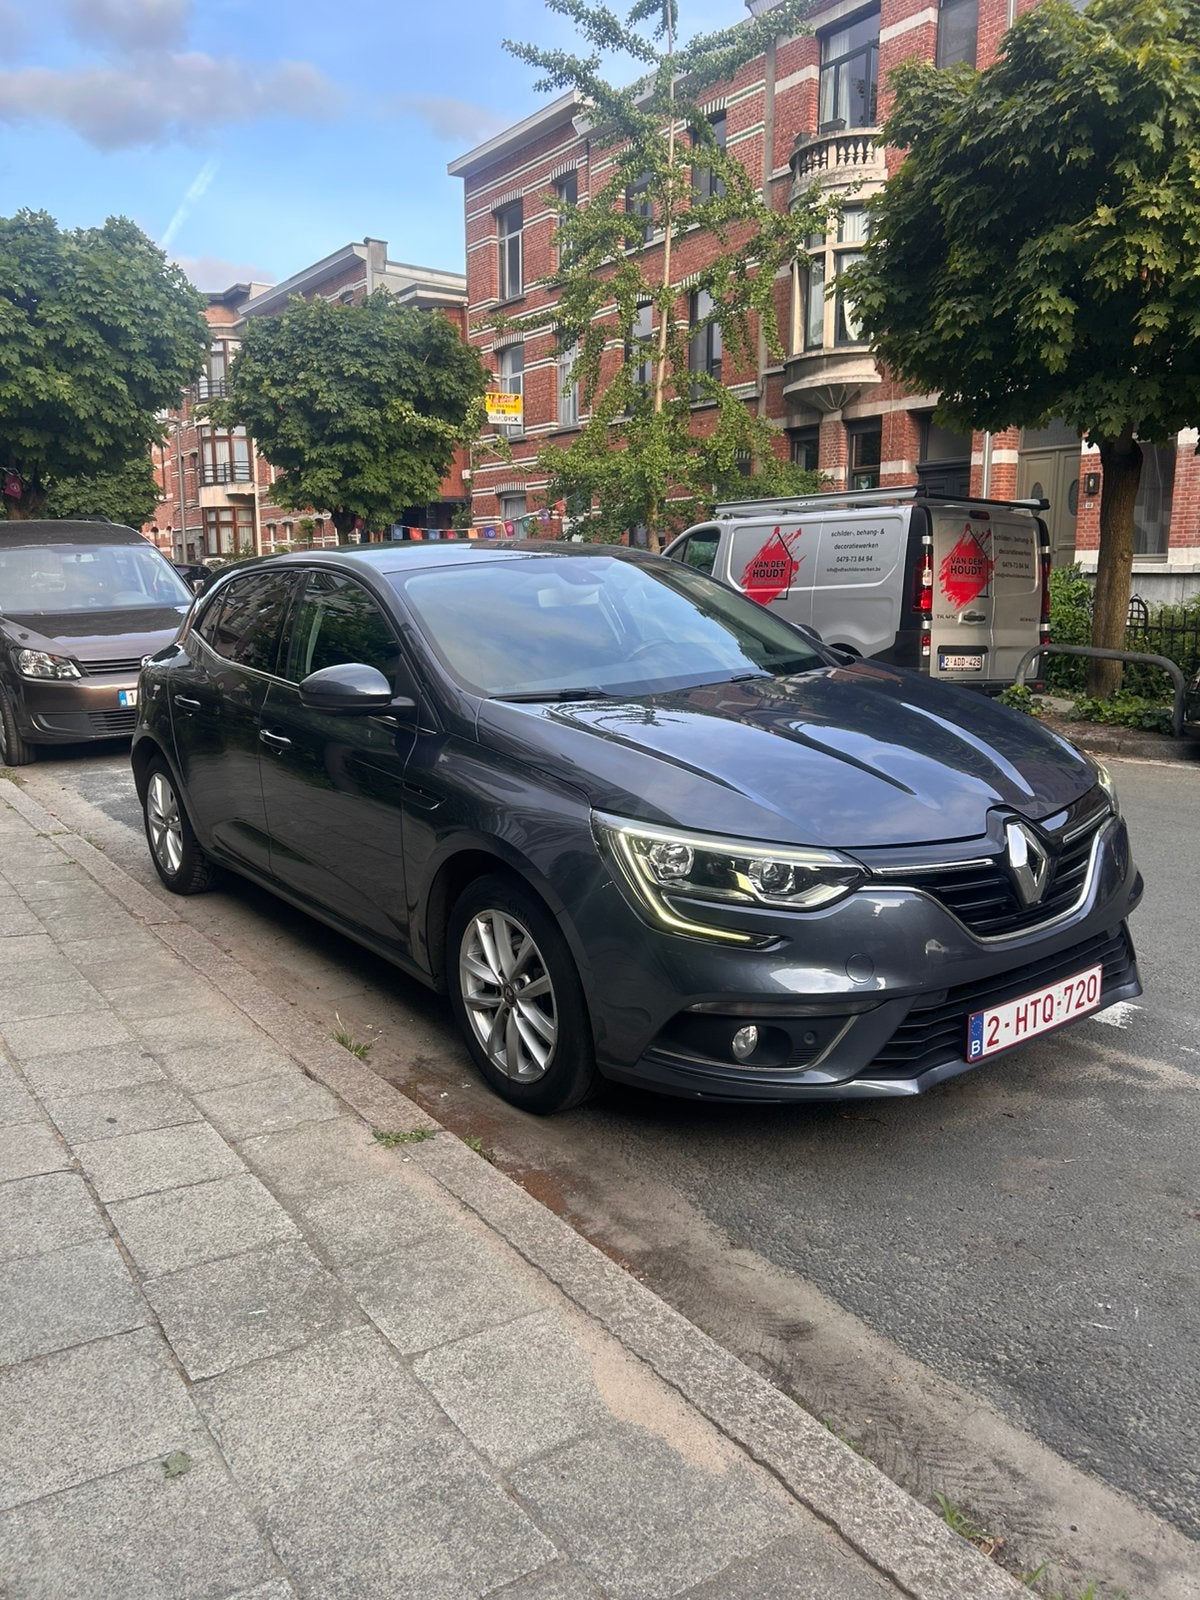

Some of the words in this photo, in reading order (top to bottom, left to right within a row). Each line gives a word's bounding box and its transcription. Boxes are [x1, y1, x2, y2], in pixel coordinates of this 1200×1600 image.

[833, 542, 879, 550] decoratiewerken
[753, 560, 769, 568] VAN
[771, 560, 786, 568] DEN
[836, 555, 857, 563] 0479-73
[968, 557, 983, 566] DEN
[752, 568, 785, 578] HOUDT
[950, 565, 983, 575] HOUDT
[945, 657, 981, 667] 2-ADD-429
[986, 974, 1098, 1048] 2-HTQ-720
[971, 1040, 981, 1054] B
